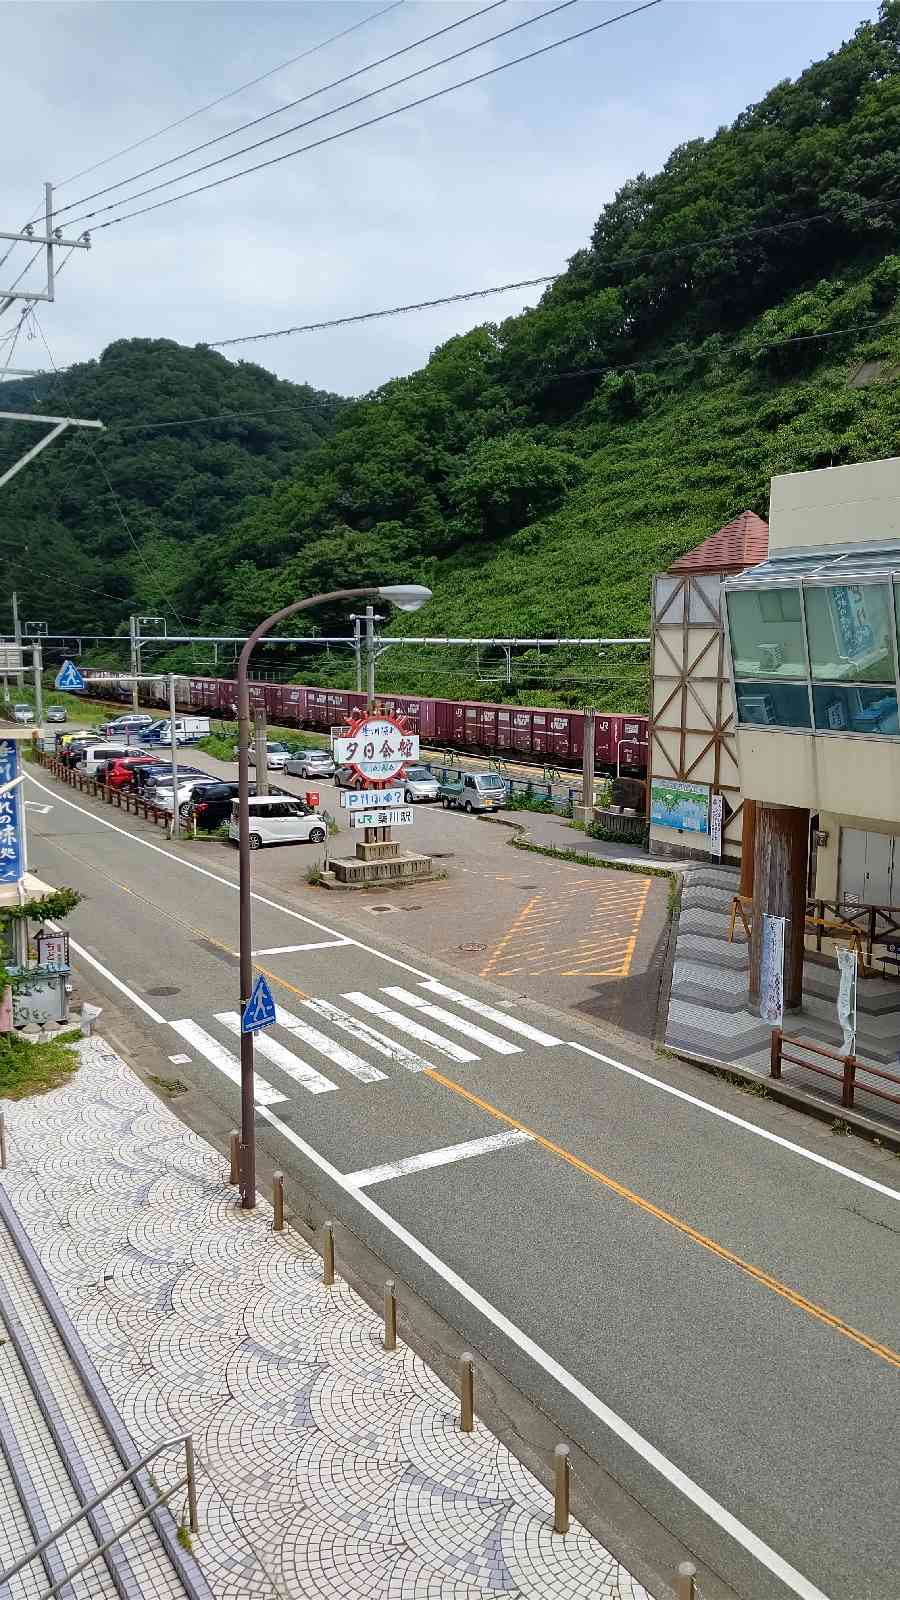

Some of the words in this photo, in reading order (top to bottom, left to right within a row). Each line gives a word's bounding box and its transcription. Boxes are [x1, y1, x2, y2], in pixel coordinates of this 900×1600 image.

[599, 721, 608, 730] JR
[344, 738, 414, 761] 夕日会館
[358, 814, 373, 824] JR
